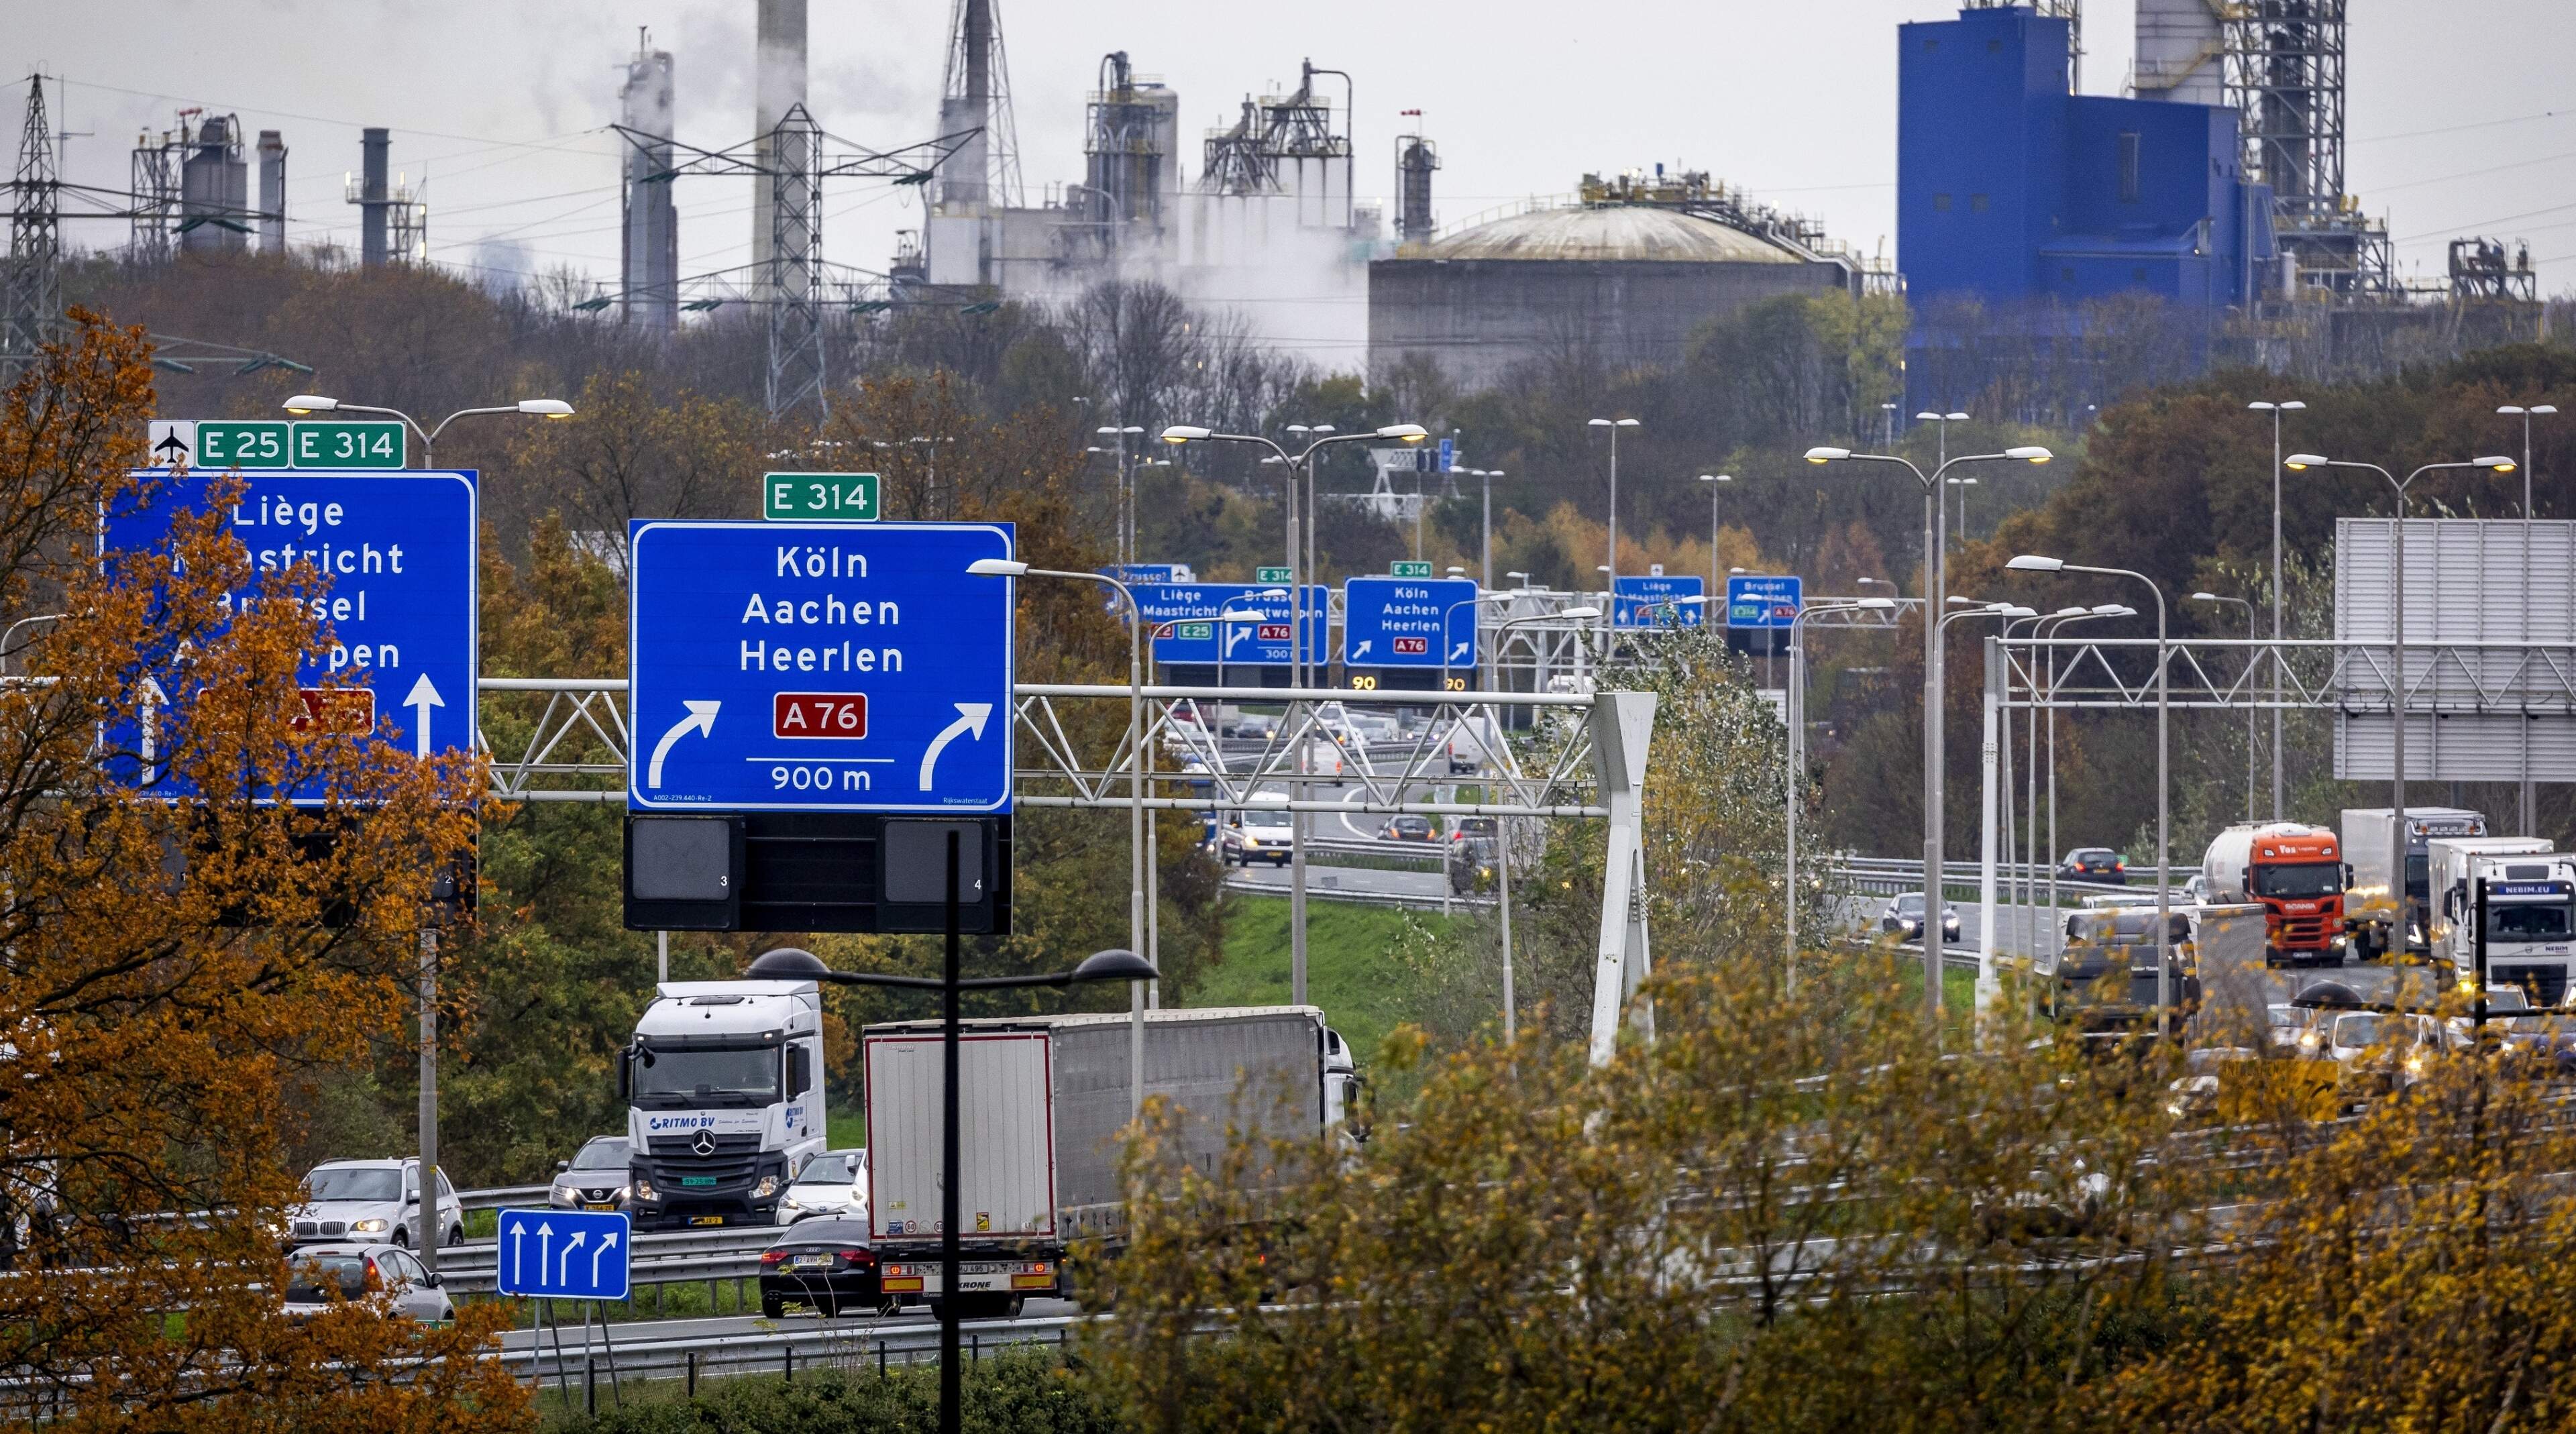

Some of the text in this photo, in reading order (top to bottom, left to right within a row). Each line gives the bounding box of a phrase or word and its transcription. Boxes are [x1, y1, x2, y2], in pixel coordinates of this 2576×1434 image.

[207, 433, 278, 458] E 25
[302, 433, 393, 457] E 314
[775, 484, 867, 510] E 314
[233, 495, 343, 535] Liège
[777, 547, 867, 577] Köln
[1260, 571, 1267, 581] E
[1394, 565, 1428, 575] E 314
[1161, 588, 1201, 604] Liège
[1395, 588, 1428, 599] Köln
[742, 594, 898, 624] Aachen
[1143, 604, 1218, 617] Maastricht
[1383, 603, 1439, 615] Aachen
[1382, 620, 1440, 632] Heerlen
[742, 640, 902, 671] Heerlen
[1266, 649, 1288, 659] 300
[1352, 676, 1376, 690] 90
[772, 767, 870, 791] 900 m
[445, 875, 451, 884] 2
[721, 875, 728, 887] 3
[975, 879, 981, 890] 4
[662, 1117, 698, 1128] RITMO
[700, 1117, 715, 1127] BV
